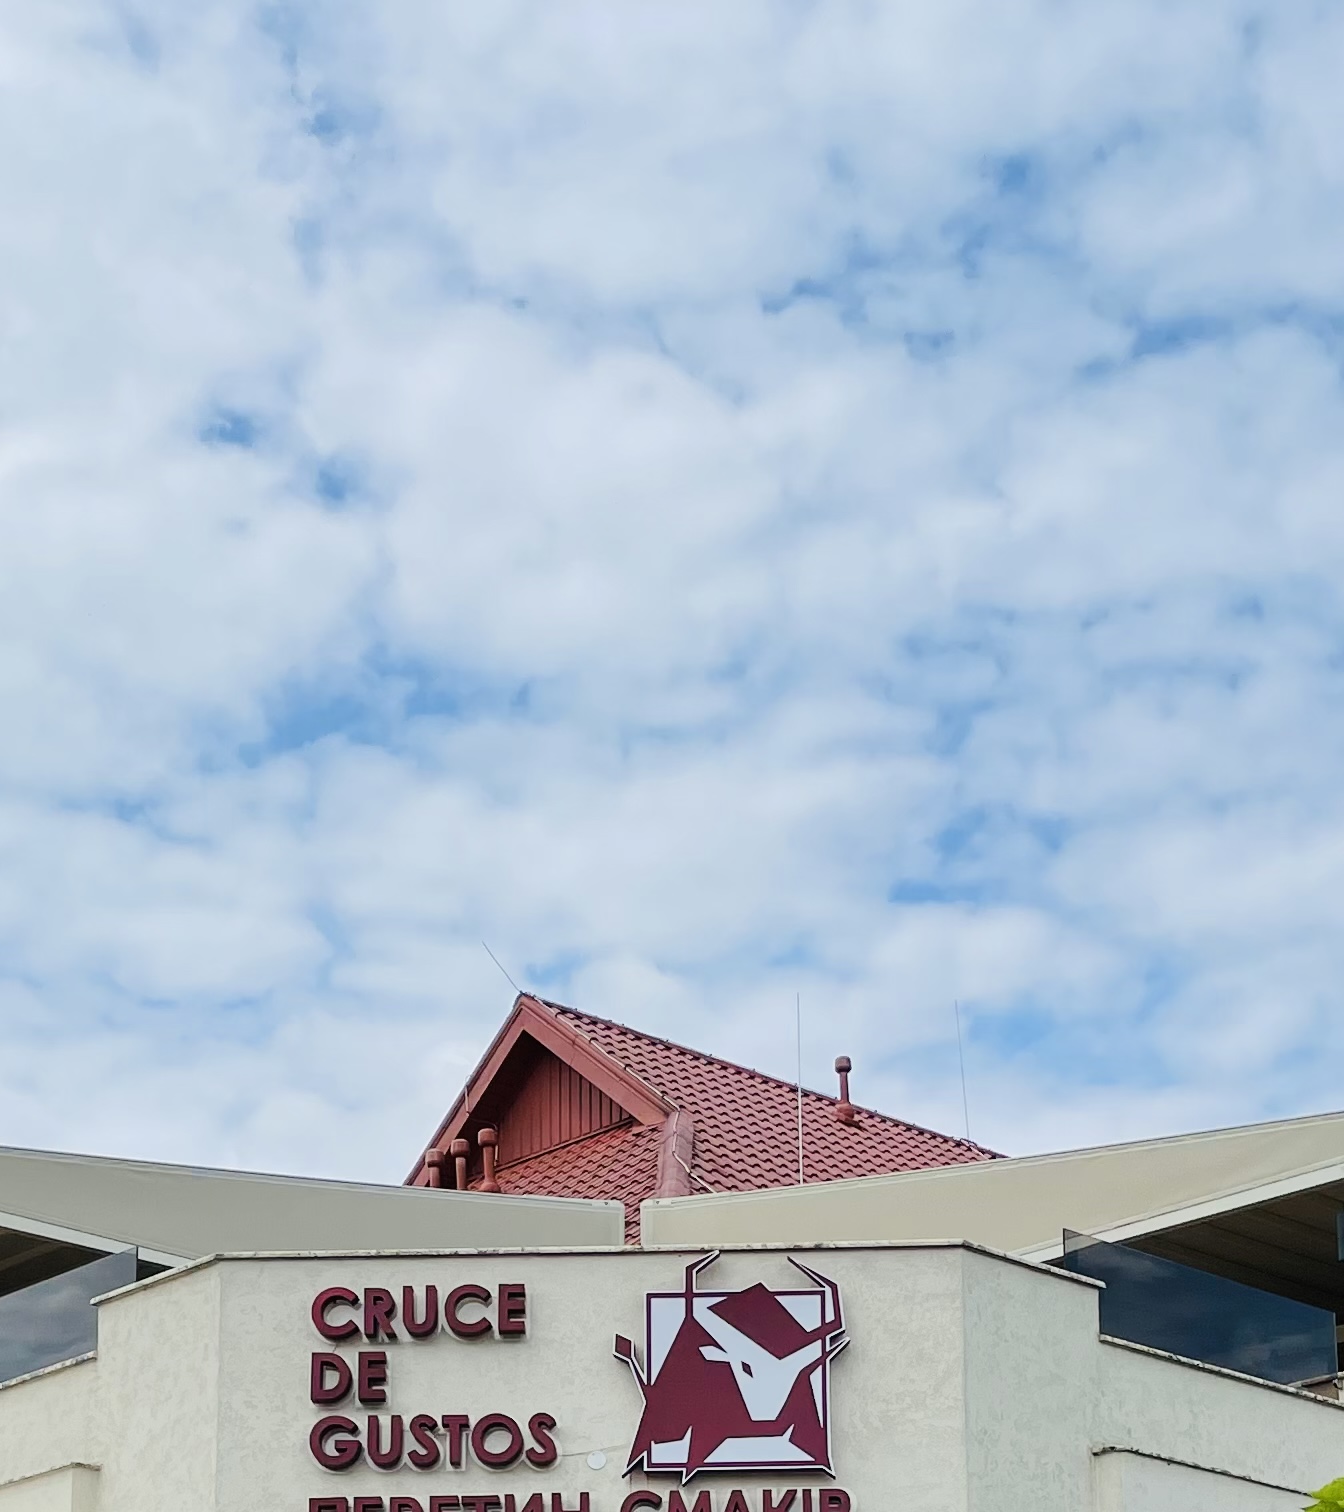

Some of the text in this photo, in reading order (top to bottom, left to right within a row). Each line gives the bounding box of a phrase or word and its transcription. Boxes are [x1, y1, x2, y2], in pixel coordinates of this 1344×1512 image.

[311, 1283, 528, 1341] CRUCE
[311, 1351, 388, 1405] DE
[310, 1413, 559, 1471] GUSTOS
